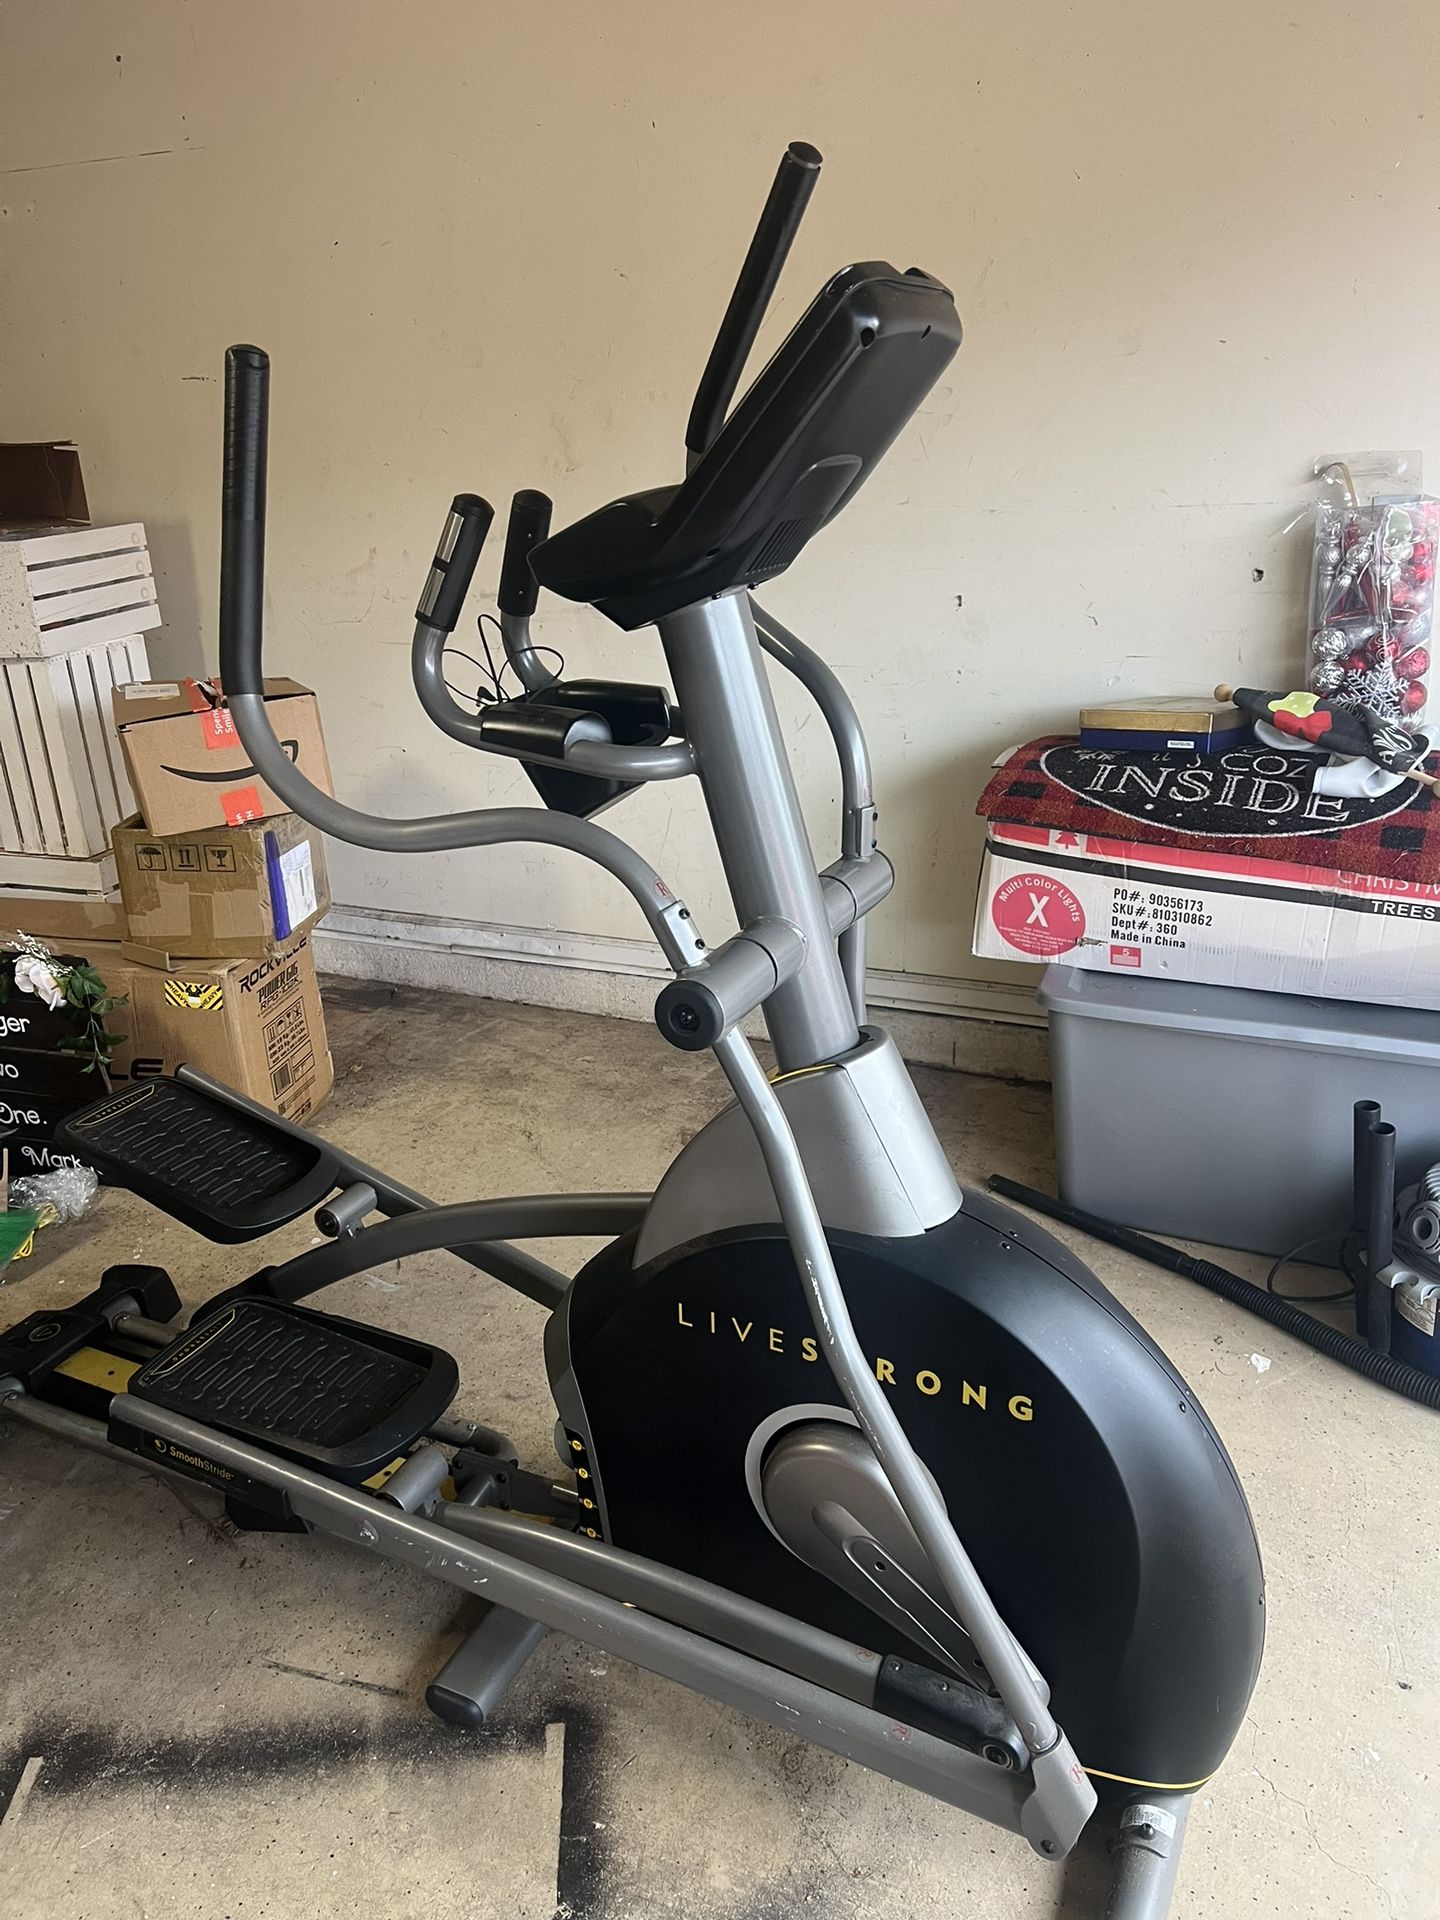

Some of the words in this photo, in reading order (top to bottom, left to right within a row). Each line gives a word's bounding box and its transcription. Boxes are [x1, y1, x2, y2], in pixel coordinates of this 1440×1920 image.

[1221, 753, 1310, 777] COZ
[1084, 764, 1350, 822] INSIDE
[999, 878, 1023, 903] Multi
[1025, 877, 1057, 890] Color
[1057, 889, 1080, 922] Lights
[1026, 892, 1050, 928] X
[1149, 893, 1204, 912] 90356173
[1371, 900, 1436, 920] TREES
[1111, 916, 1153, 932] Dept#:
[1156, 922, 1178, 935] 360
[1110, 929, 1139, 942] Made
[1142, 933, 1152, 944] in
[1154, 935, 1186, 949] China
[169, 985, 188, 1004] HEAVY
[201, 990, 218, 1007] HEAVY
[21, 1146, 82, 1169] Mark
[678, 1302, 1033, 1422] LIVESRONG
